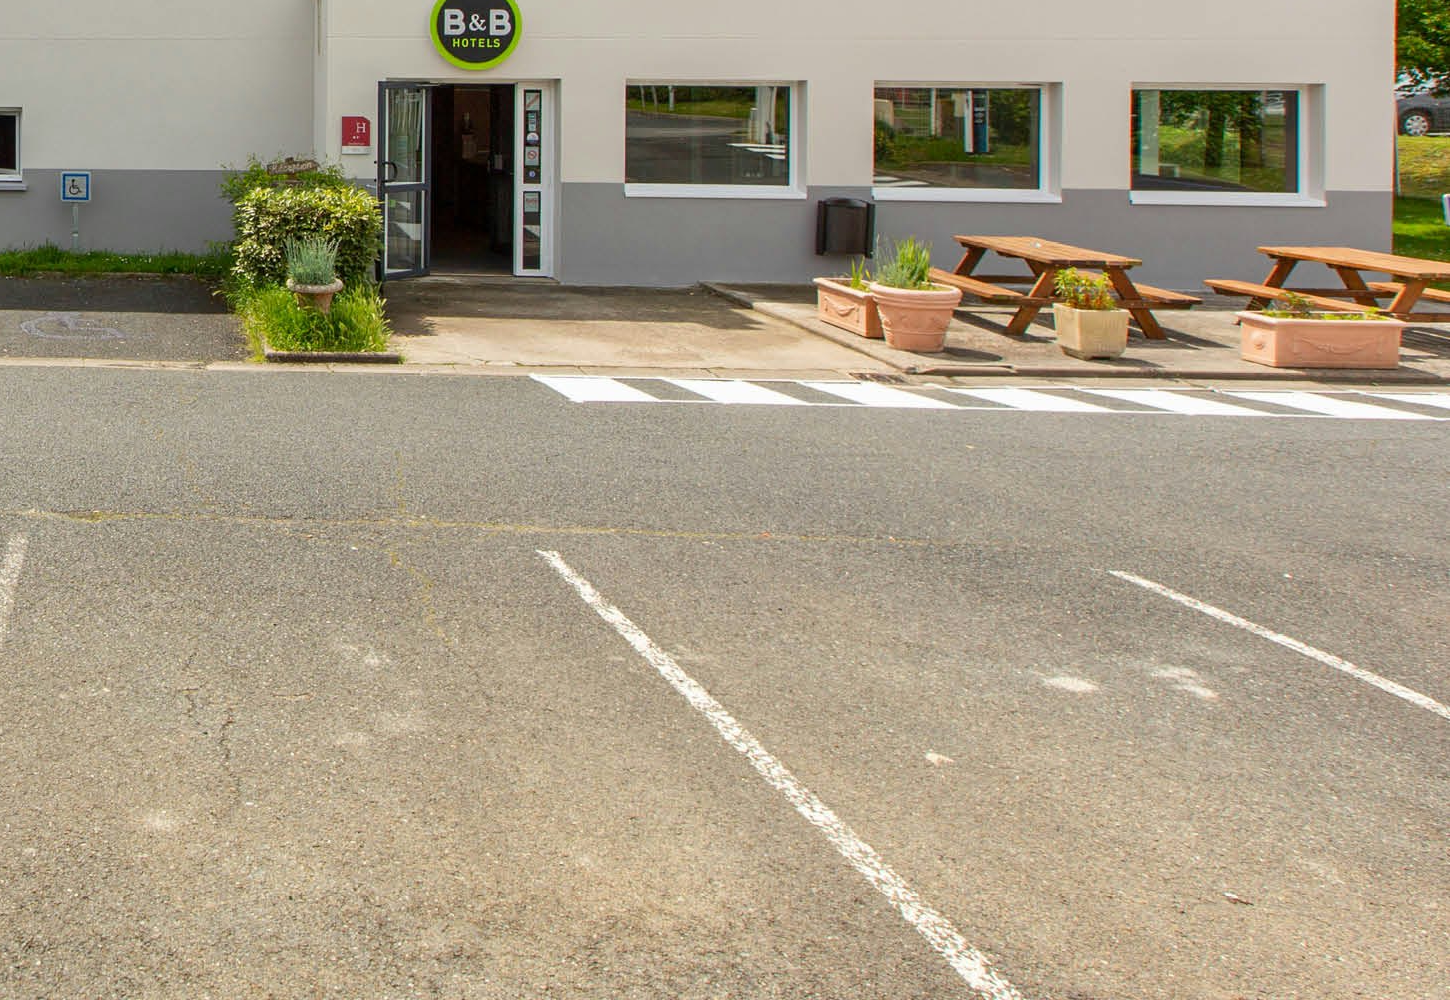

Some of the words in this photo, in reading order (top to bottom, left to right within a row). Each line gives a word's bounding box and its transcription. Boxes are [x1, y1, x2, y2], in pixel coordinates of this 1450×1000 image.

[444, 8, 512, 36] B&B
[452, 38, 501, 48] HOTELS
[356, 122, 366, 133] H
